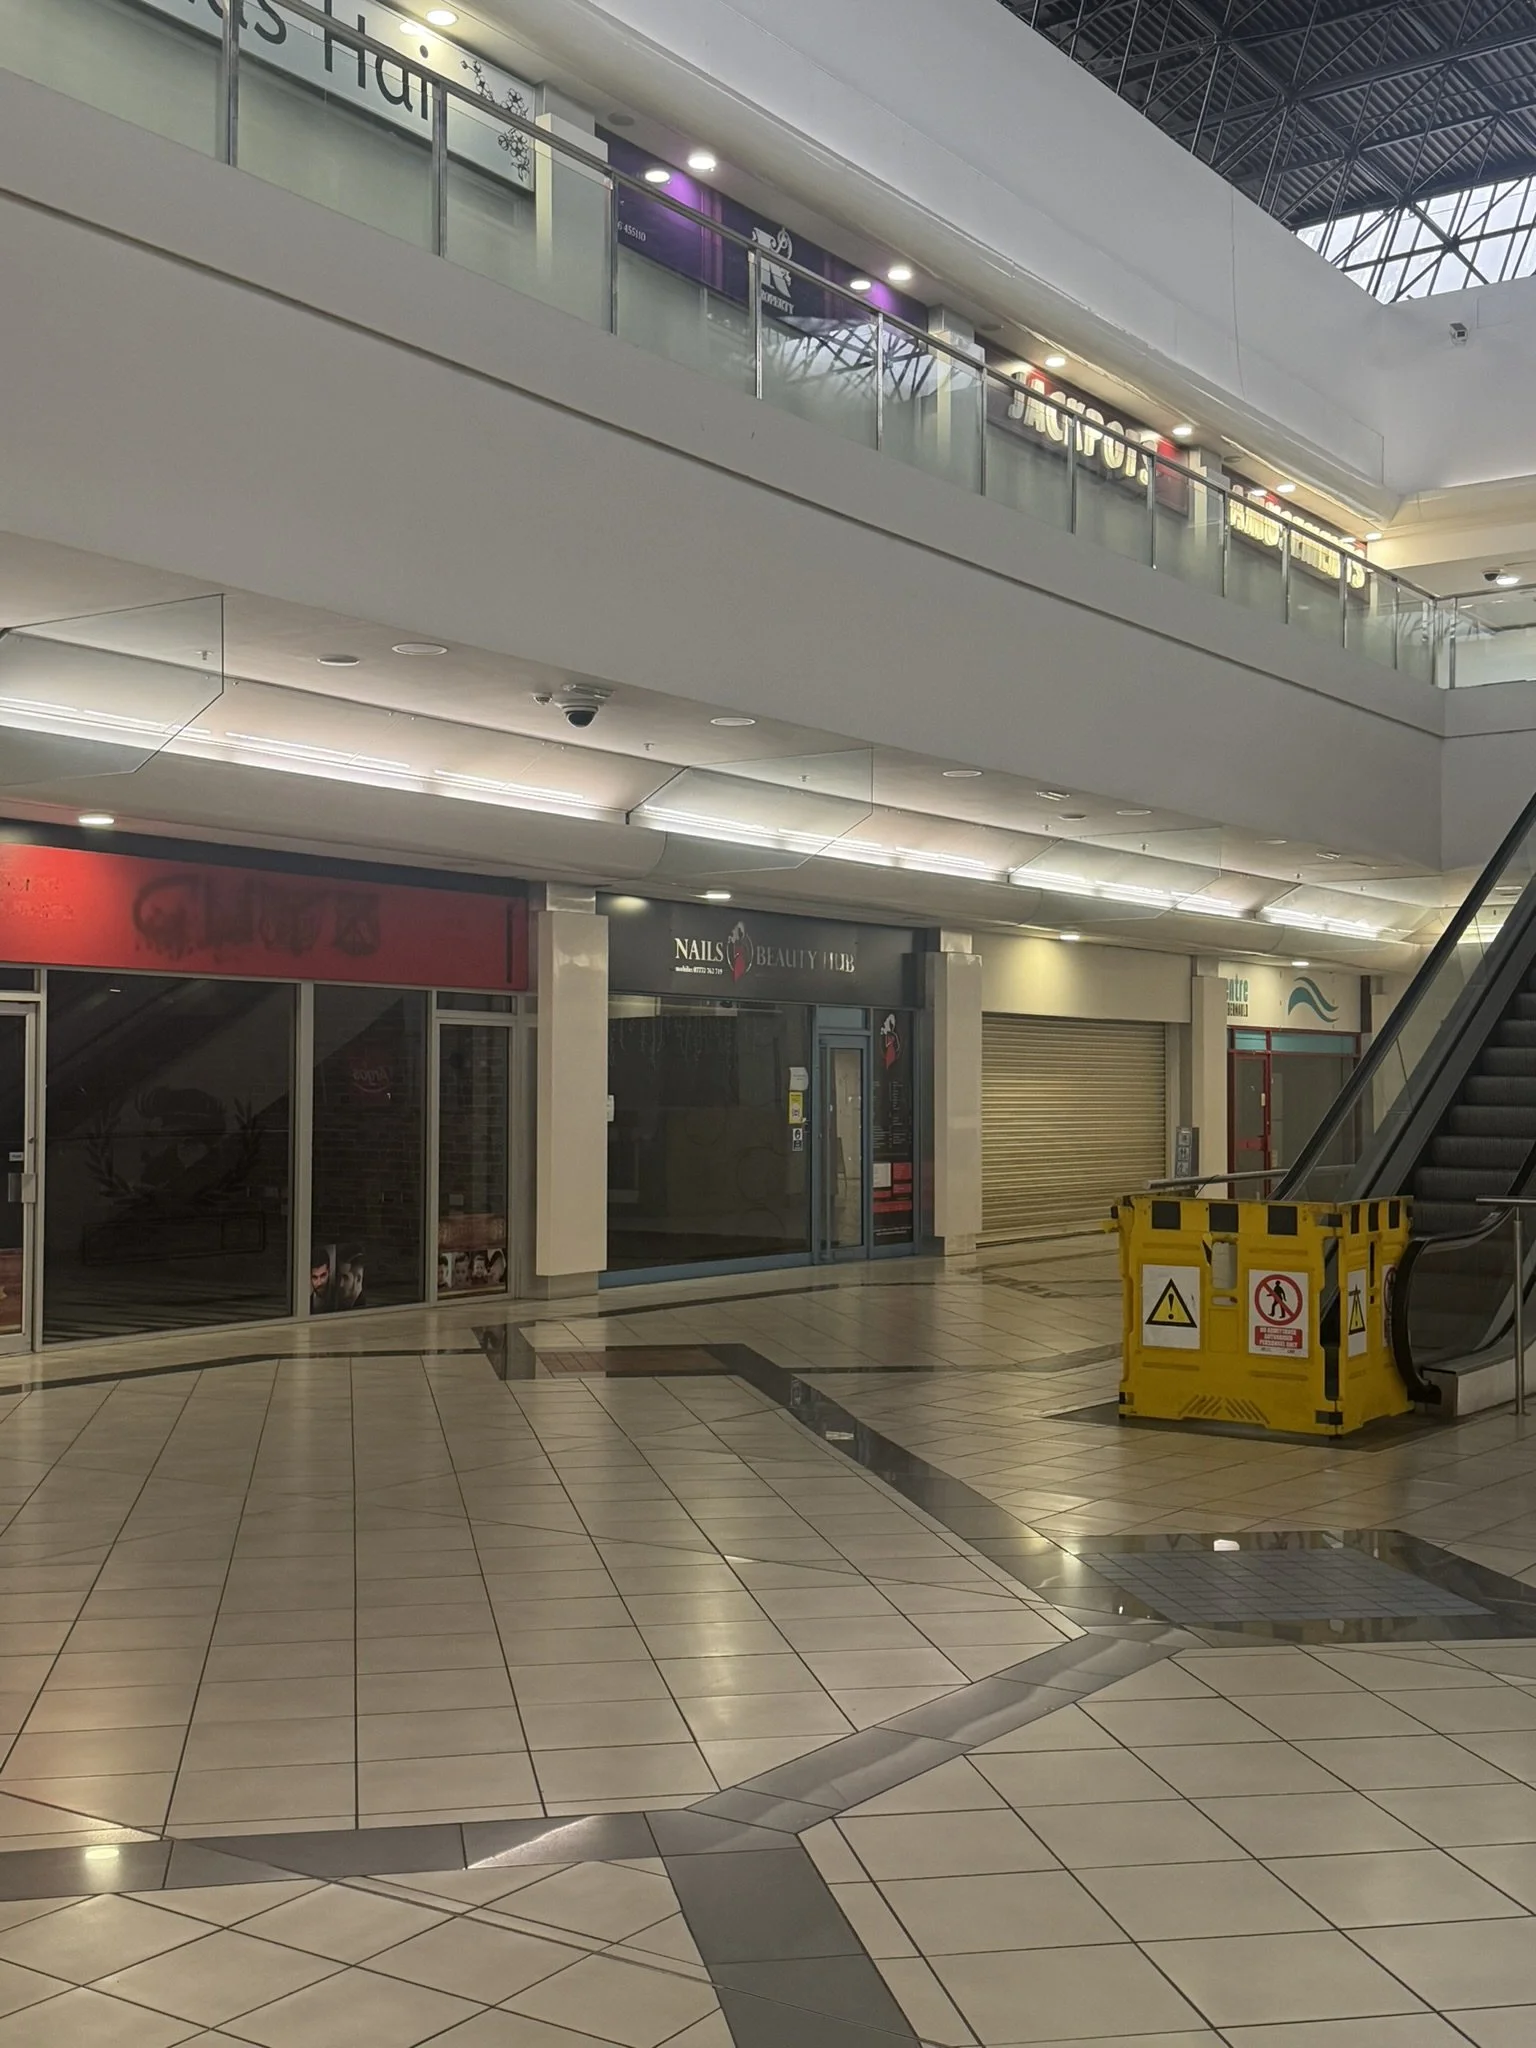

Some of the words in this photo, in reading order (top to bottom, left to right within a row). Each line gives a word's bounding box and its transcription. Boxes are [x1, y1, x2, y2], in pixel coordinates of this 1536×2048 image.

[1007, 371, 1157, 487] JACKPOTS
[674, 938, 725, 962] NAILS
[756, 945, 818, 971] BEAUTY
